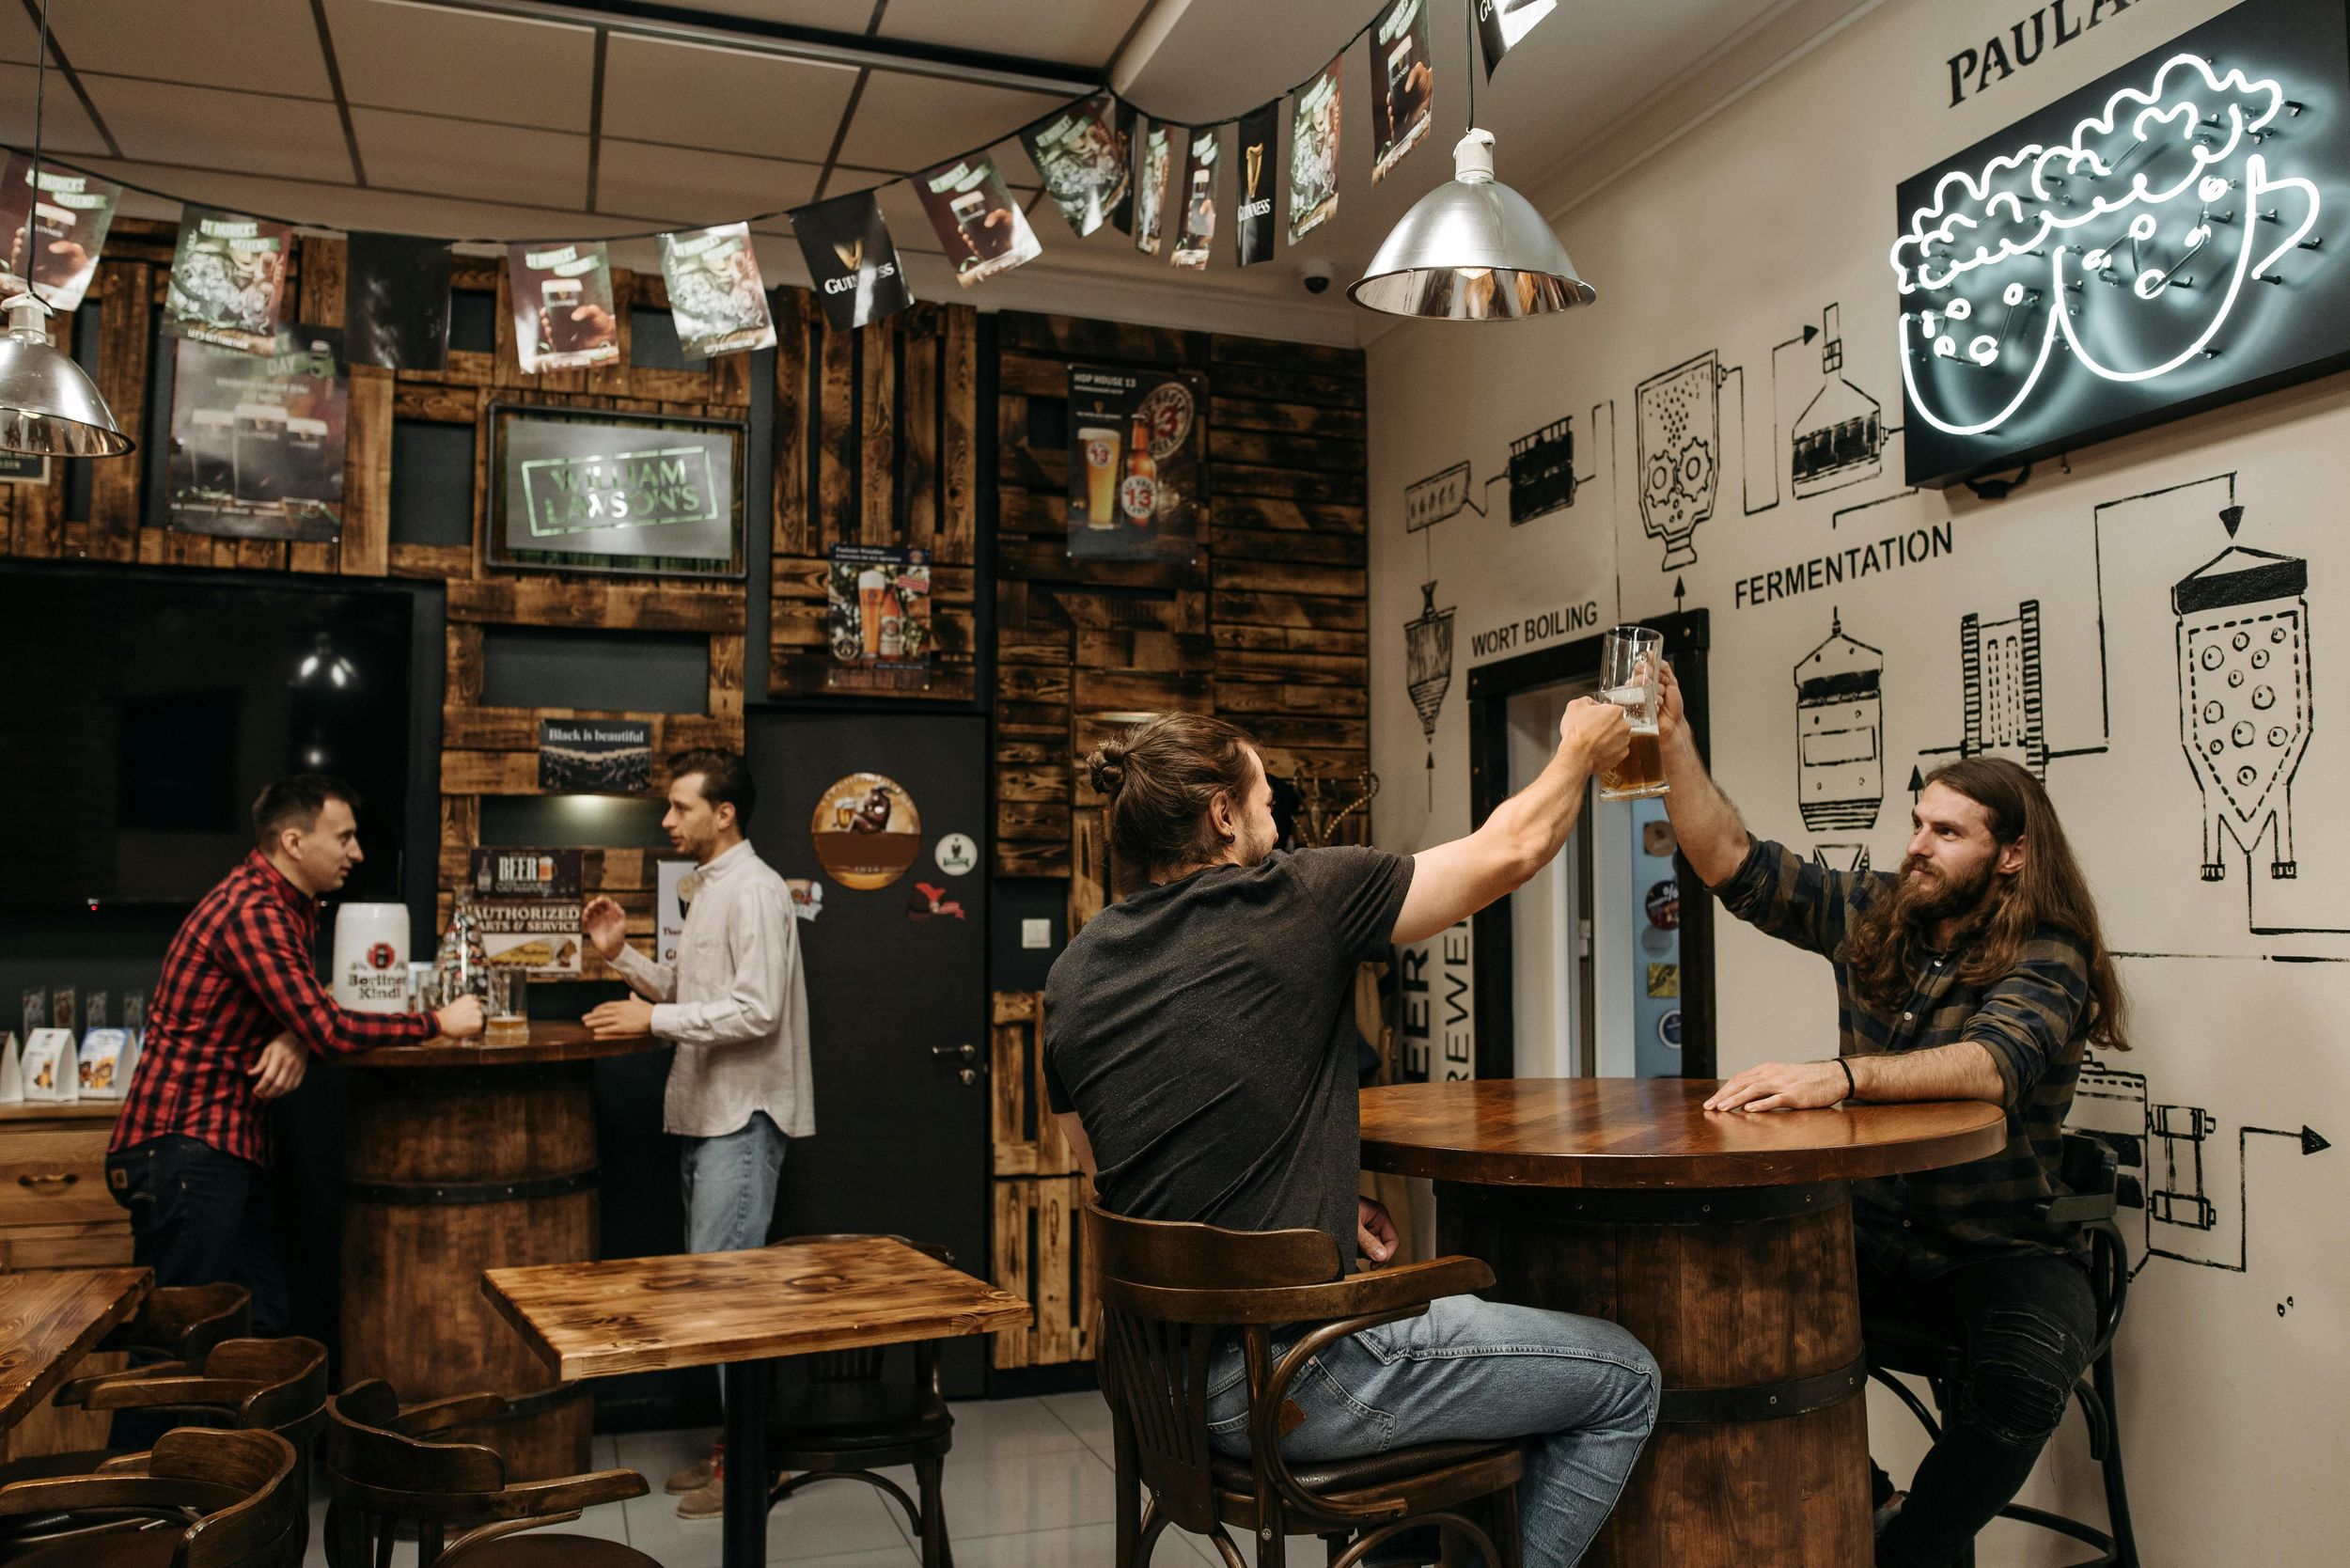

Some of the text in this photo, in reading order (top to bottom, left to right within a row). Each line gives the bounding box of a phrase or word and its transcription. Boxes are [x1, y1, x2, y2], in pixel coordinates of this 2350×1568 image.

[1128, 488, 1152, 507] 13
[1735, 522, 1953, 609] FERMENTATION
[1471, 601, 1598, 657] WORT BOILING
[549, 728, 644, 744] Black is beautiful
[498, 855, 537, 882] BEER
[473, 906, 580, 921] AUTHORIZED
[479, 921, 509, 933] ARTS
[526, 921, 580, 933] SERVICE
[348, 972, 407, 987] Berliner
[358, 987, 401, 1001] Kindl
[1402, 949, 1429, 1082] EER
